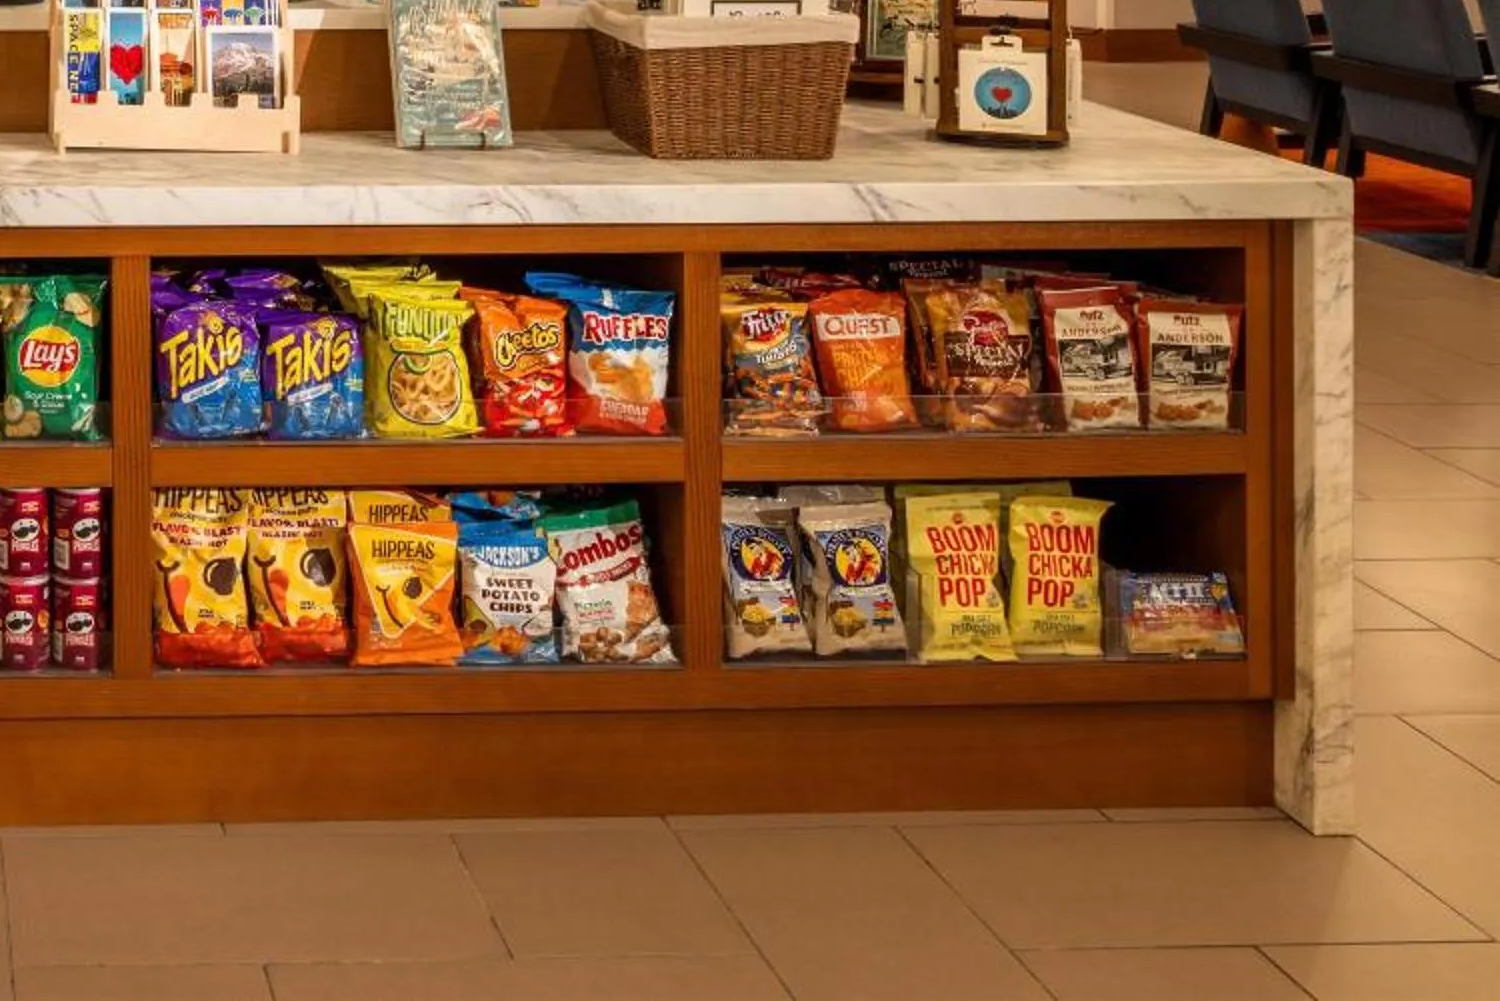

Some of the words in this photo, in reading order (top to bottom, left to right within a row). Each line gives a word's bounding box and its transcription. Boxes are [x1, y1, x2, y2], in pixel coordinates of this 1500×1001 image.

[582, 312, 669, 344] RUFFLES
[824, 316, 891, 336] QUEST
[1156, 333, 1224, 343] ANDERSON
[25, 340, 77, 371] Lay's
[495, 322, 560, 368] Cheetos
[160, 327, 243, 399] Takis
[267, 331, 351, 400] Takis
[368, 503, 429, 523] HIPPEAS
[371, 538, 436, 560] HIPPEAS
[927, 523, 996, 553] BOOM
[1025, 523, 1095, 554] BOOM
[479, 546, 540, 565] JACKSON'S
[1029, 554, 1093, 577] CHICKA
[481, 589, 541, 602] POTATO
[486, 577, 533, 590] SWEET
[938, 577, 986, 608] POP
[1027, 577, 1075, 608] POP
[489, 601, 534, 614] CHIPS
